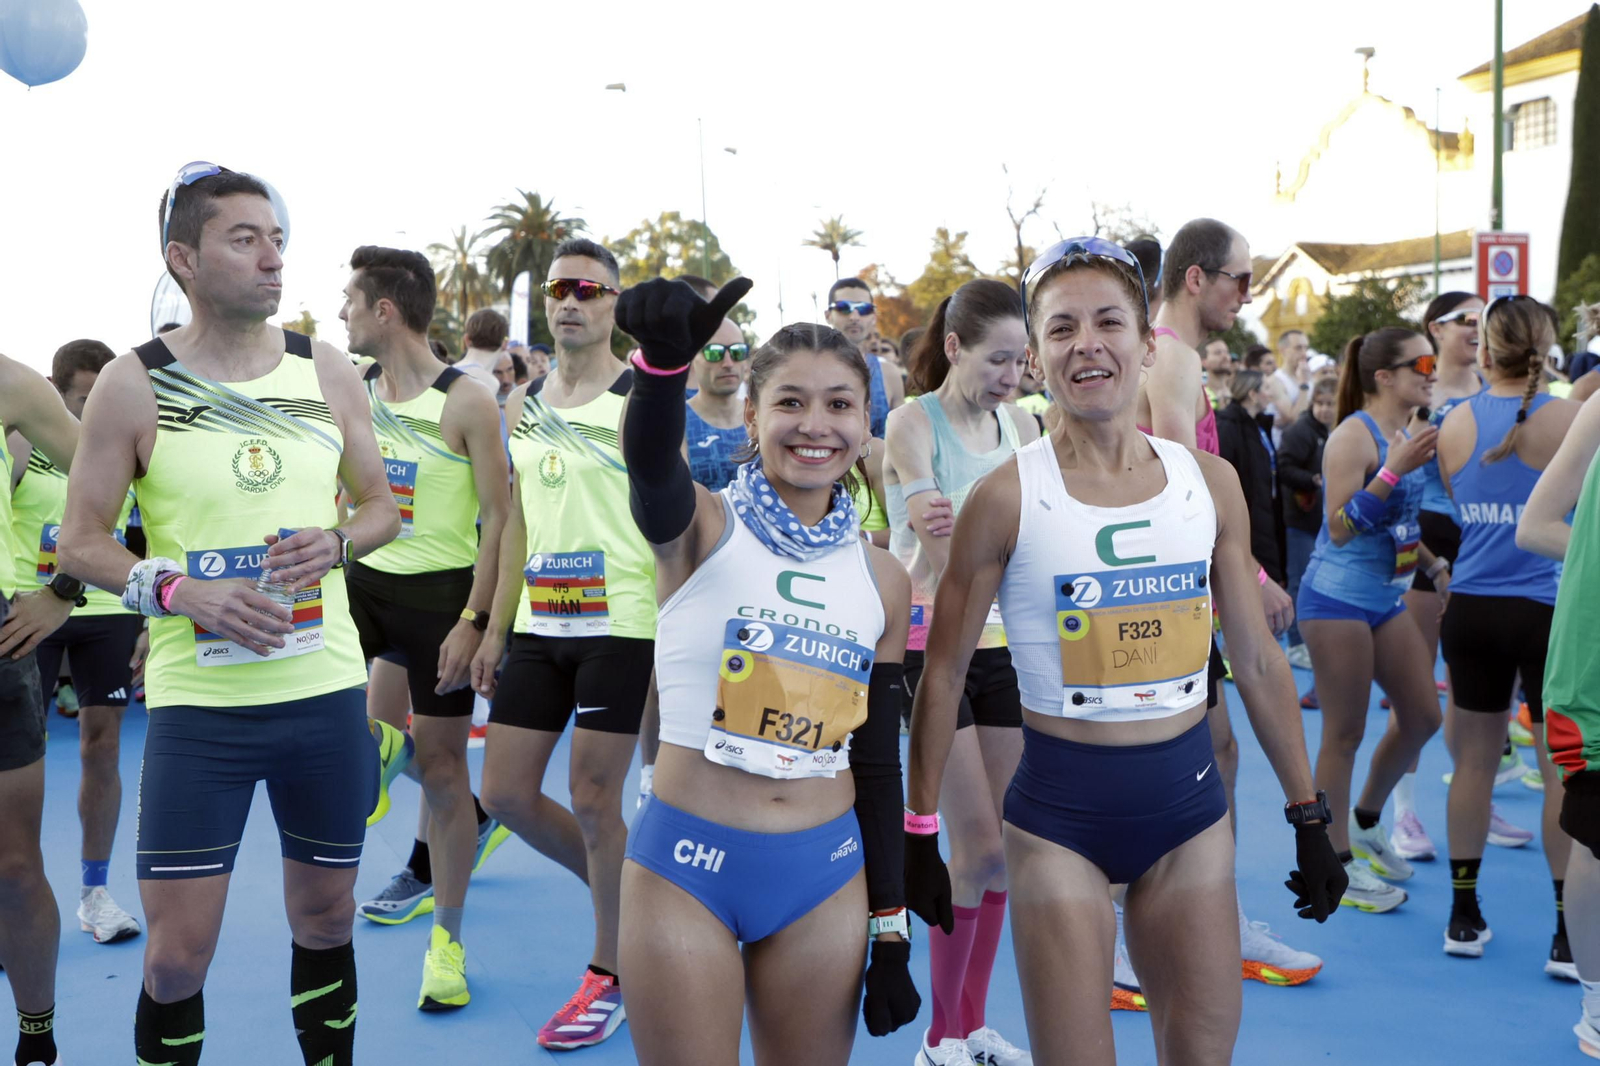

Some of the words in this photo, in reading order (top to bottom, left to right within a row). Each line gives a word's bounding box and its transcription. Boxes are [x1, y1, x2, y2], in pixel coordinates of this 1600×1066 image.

[235, 480, 268, 493] GUARDIA
[269, 476, 286, 490] CIVIL
[1095, 519, 1156, 567] C
[546, 556, 593, 569] ZURICH
[552, 582, 570, 594] 475
[776, 570, 826, 610] C
[1112, 572, 1195, 598] ZURICH
[547, 595, 582, 615] IVÁN
[1118, 619, 1163, 641] F323
[783, 633, 862, 672] ZURICH
[758, 707, 824, 749] F321
[906, 820, 934, 829] Maratón
[673, 839, 726, 873] CHI
